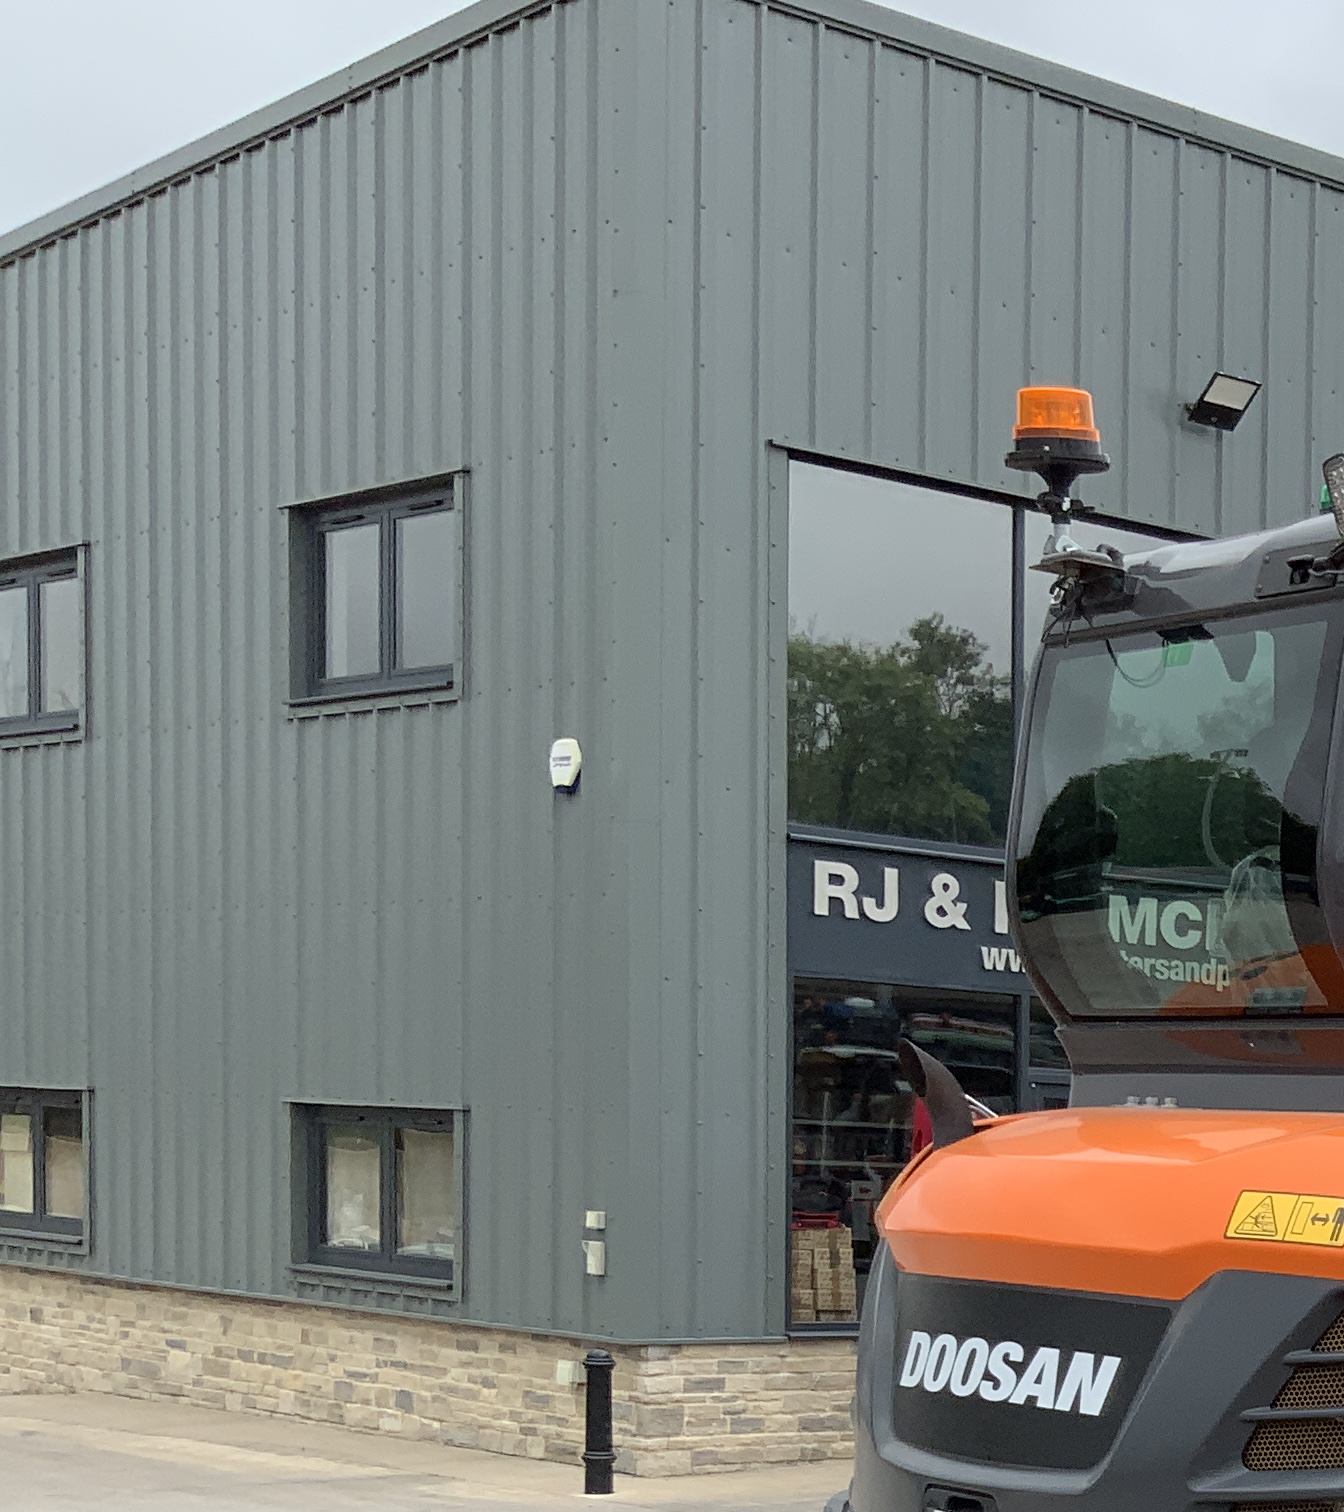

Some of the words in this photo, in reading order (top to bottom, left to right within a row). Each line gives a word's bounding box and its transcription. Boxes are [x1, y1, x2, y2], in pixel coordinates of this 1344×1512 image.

[813, 859, 899, 922] RJ
[924, 873, 971, 930] &
[899, 1330, 1122, 1416] DOOSAN
